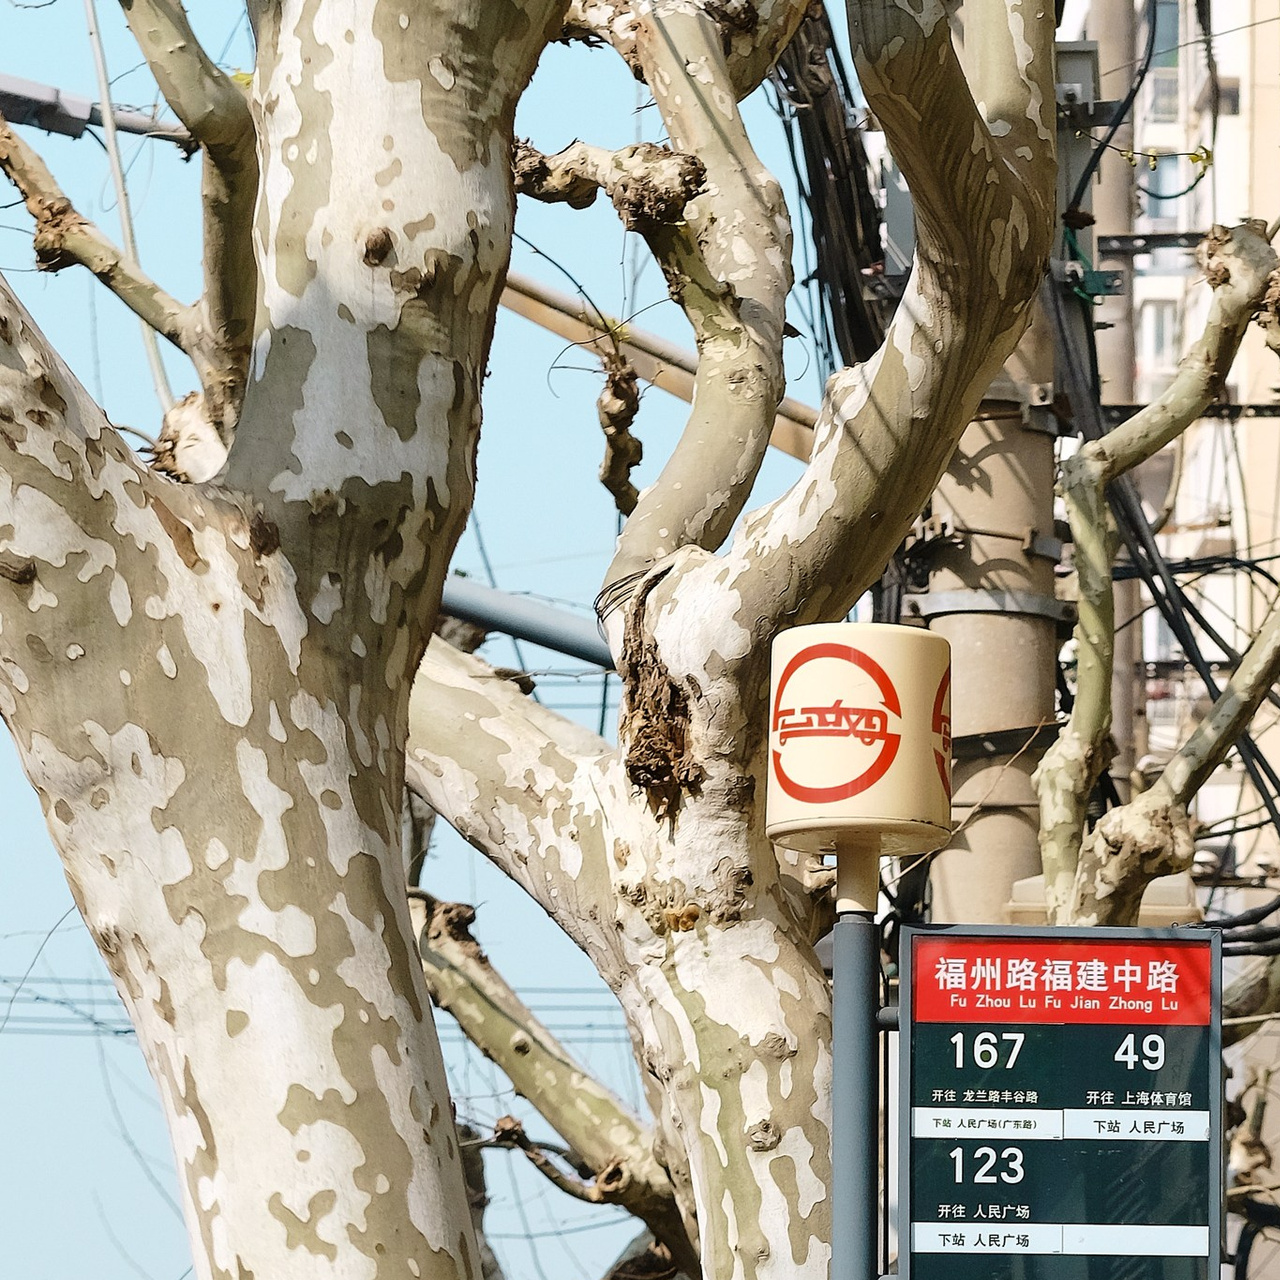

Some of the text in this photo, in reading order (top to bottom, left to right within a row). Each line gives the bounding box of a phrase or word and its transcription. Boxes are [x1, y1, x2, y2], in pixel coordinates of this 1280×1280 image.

[935, 957, 1180, 993] 福州路福建中路
[950, 994, 1179, 1012] Fu Zhou Lu Fu Jian Zhong Lu
[950, 1031, 1025, 1069] 167
[1114, 1033, 1166, 1071] 49
[932, 1089, 1038, 1104] 开往 龙兰路丰谷路
[1086, 1090, 1192, 1107] 开往 上海体育馆
[932, 1118, 1037, 1130] 下站 人民广场(广东路)
[1093, 1119, 1185, 1135] 下站 人民广场
[949, 1146, 1025, 1184] 123
[938, 1203, 1030, 1219] 开往 人民广场
[938, 1233, 1030, 1248] 下站 人民广场
